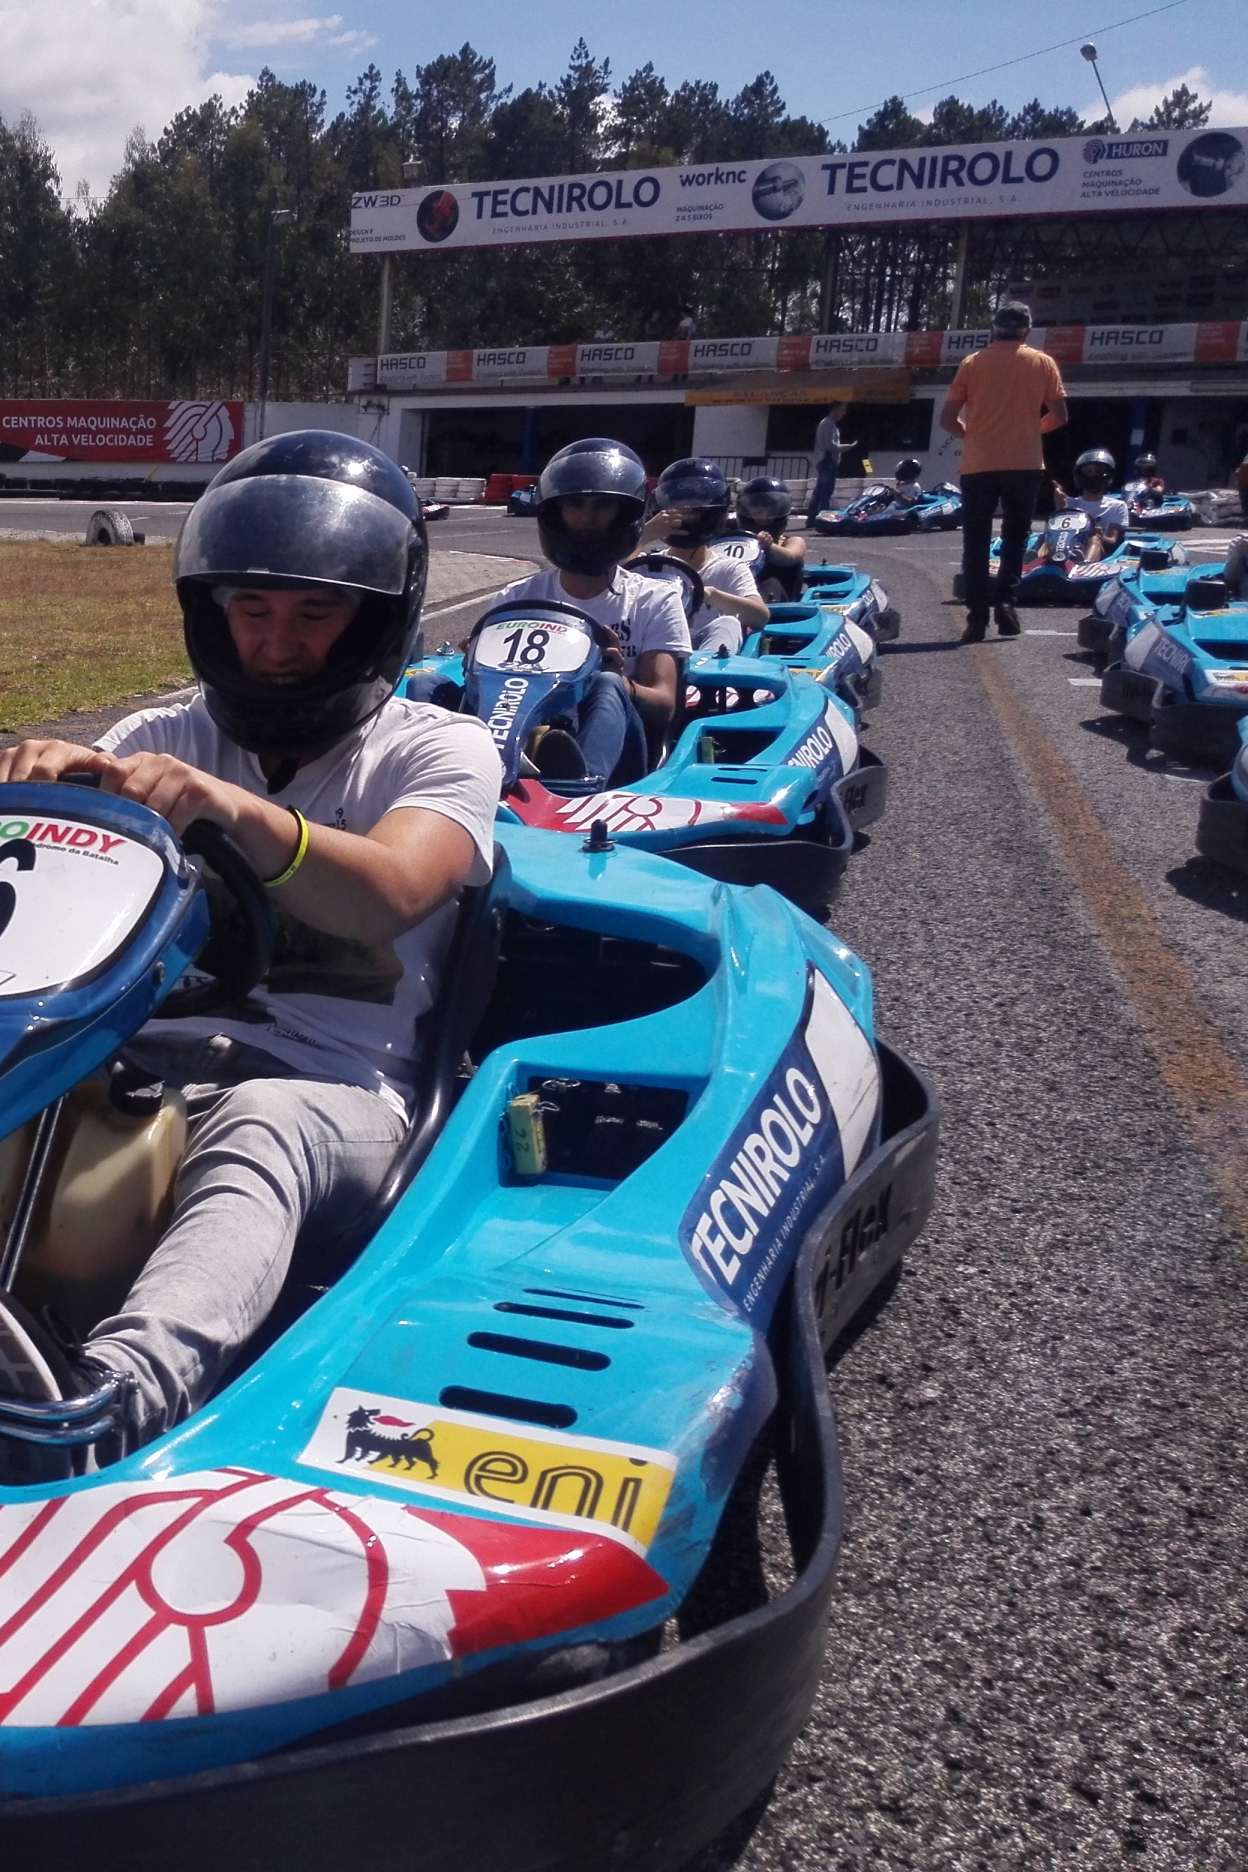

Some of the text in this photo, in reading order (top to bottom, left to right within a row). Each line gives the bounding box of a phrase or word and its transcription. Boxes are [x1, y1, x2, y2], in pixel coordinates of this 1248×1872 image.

[1112, 142, 1164, 157] HURON
[680, 167, 747, 187] worknc
[821, 147, 1060, 195] TECNIROLO
[1083, 169, 1123, 178] CENTROS
[471, 176, 661, 219] TECNIROLO
[1080, 190, 1102, 198] ALTA
[847, 201, 916, 211] ENGENHARIA
[816, 338, 878, 353] HASCO
[947, 334, 991, 350] HAS
[1090, 330, 1164, 346] HASCO
[580, 347, 635, 361] HASCO
[694, 343, 752, 357] HASCO
[380, 357, 427, 371] HASCO
[477, 352, 526, 366] HASCO
[2, 415, 157, 431] CENTROS MAQUINAÇÃO
[34, 434, 153, 446] ALTA VELOCIDADE
[1062, 518, 1071, 529] 6
[724, 545, 744, 559] 10
[496, 621, 568, 633] EUROIND
[503, 628, 550, 664] 18
[788, 726, 833, 768] NIROLO
[689, 1067, 823, 1285] TECNIROLO
[743, 1238, 783, 1312] ENGENHARIA
[464, 1450, 648, 1533] eni
